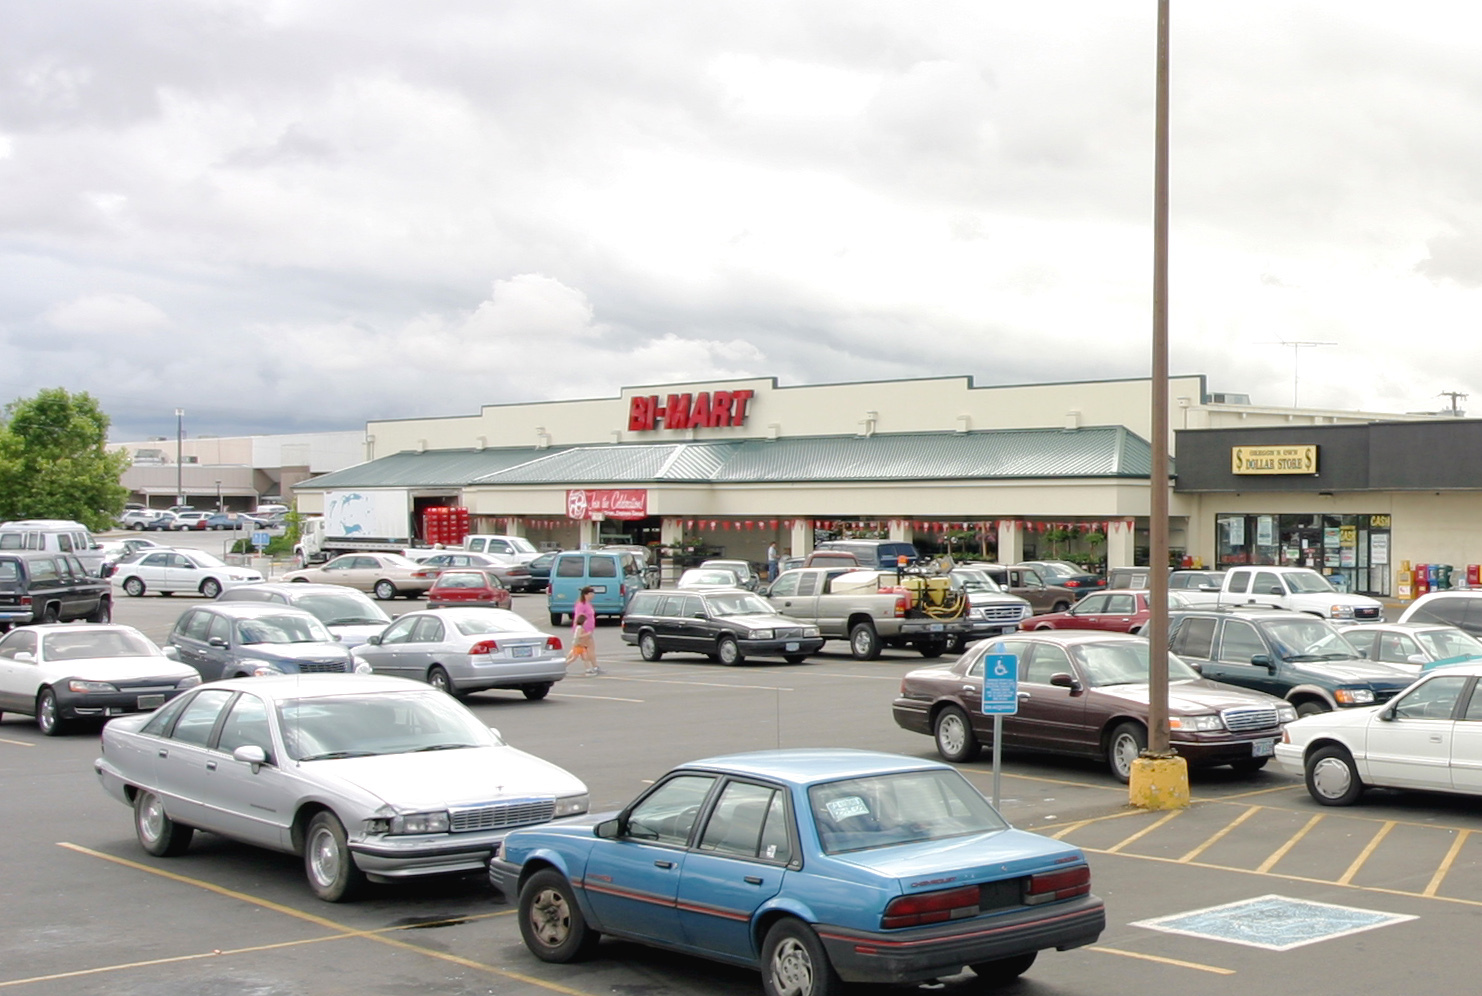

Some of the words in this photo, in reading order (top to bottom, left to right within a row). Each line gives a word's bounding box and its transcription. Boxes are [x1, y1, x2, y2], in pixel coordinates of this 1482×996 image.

[628, 389, 754, 431] BI-MART
[1245, 458, 1275, 470] DOLLAR
[1277, 458, 1303, 470] STORE
[1370, 515, 1390, 527] CASH
